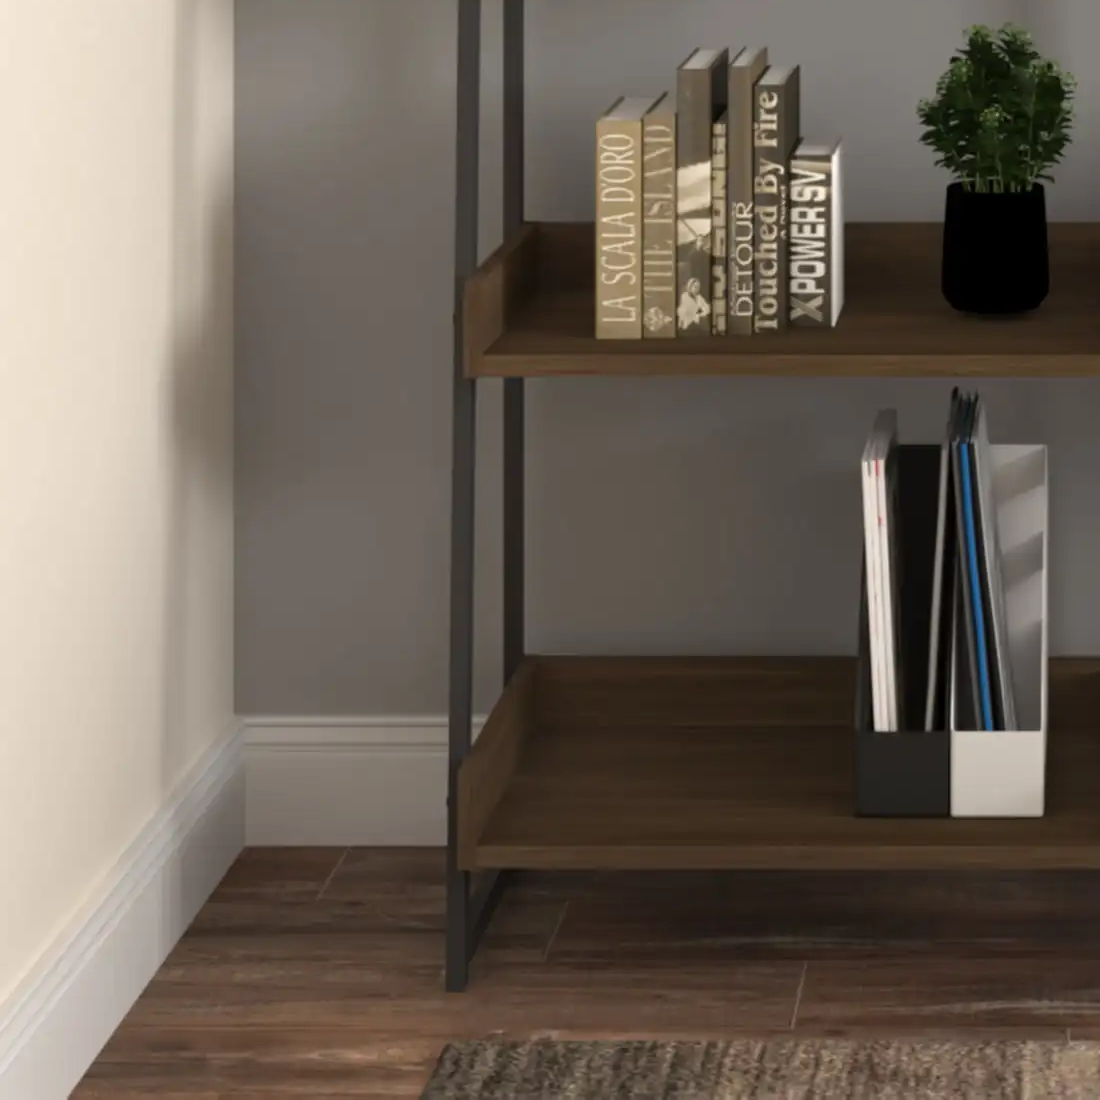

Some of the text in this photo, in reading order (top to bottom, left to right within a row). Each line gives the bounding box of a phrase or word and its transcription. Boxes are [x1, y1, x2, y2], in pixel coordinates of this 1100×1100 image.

[601, 132, 638, 322] LA SCALA D'ORO
[735, 202, 754, 317] DETOUR
[755, 90, 785, 332] Touched By Fire
